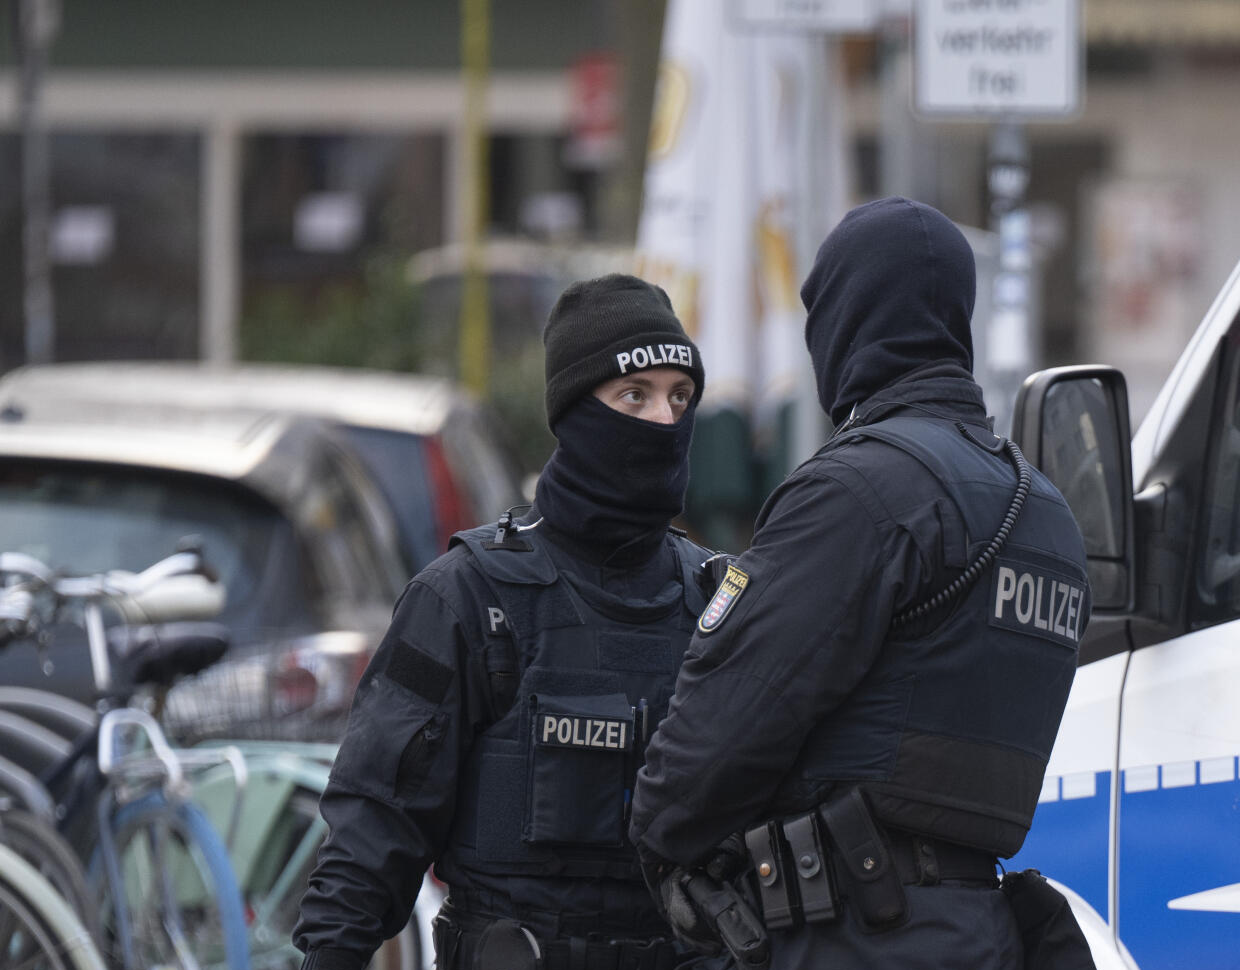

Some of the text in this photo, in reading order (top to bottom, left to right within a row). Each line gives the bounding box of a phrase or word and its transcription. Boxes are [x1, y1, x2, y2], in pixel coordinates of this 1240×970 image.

[616, 343, 693, 374] POLIZEI
[487, 606, 510, 632] P
[994, 566, 1084, 642] POLIZEI
[542, 715, 626, 749] POLIZEI
